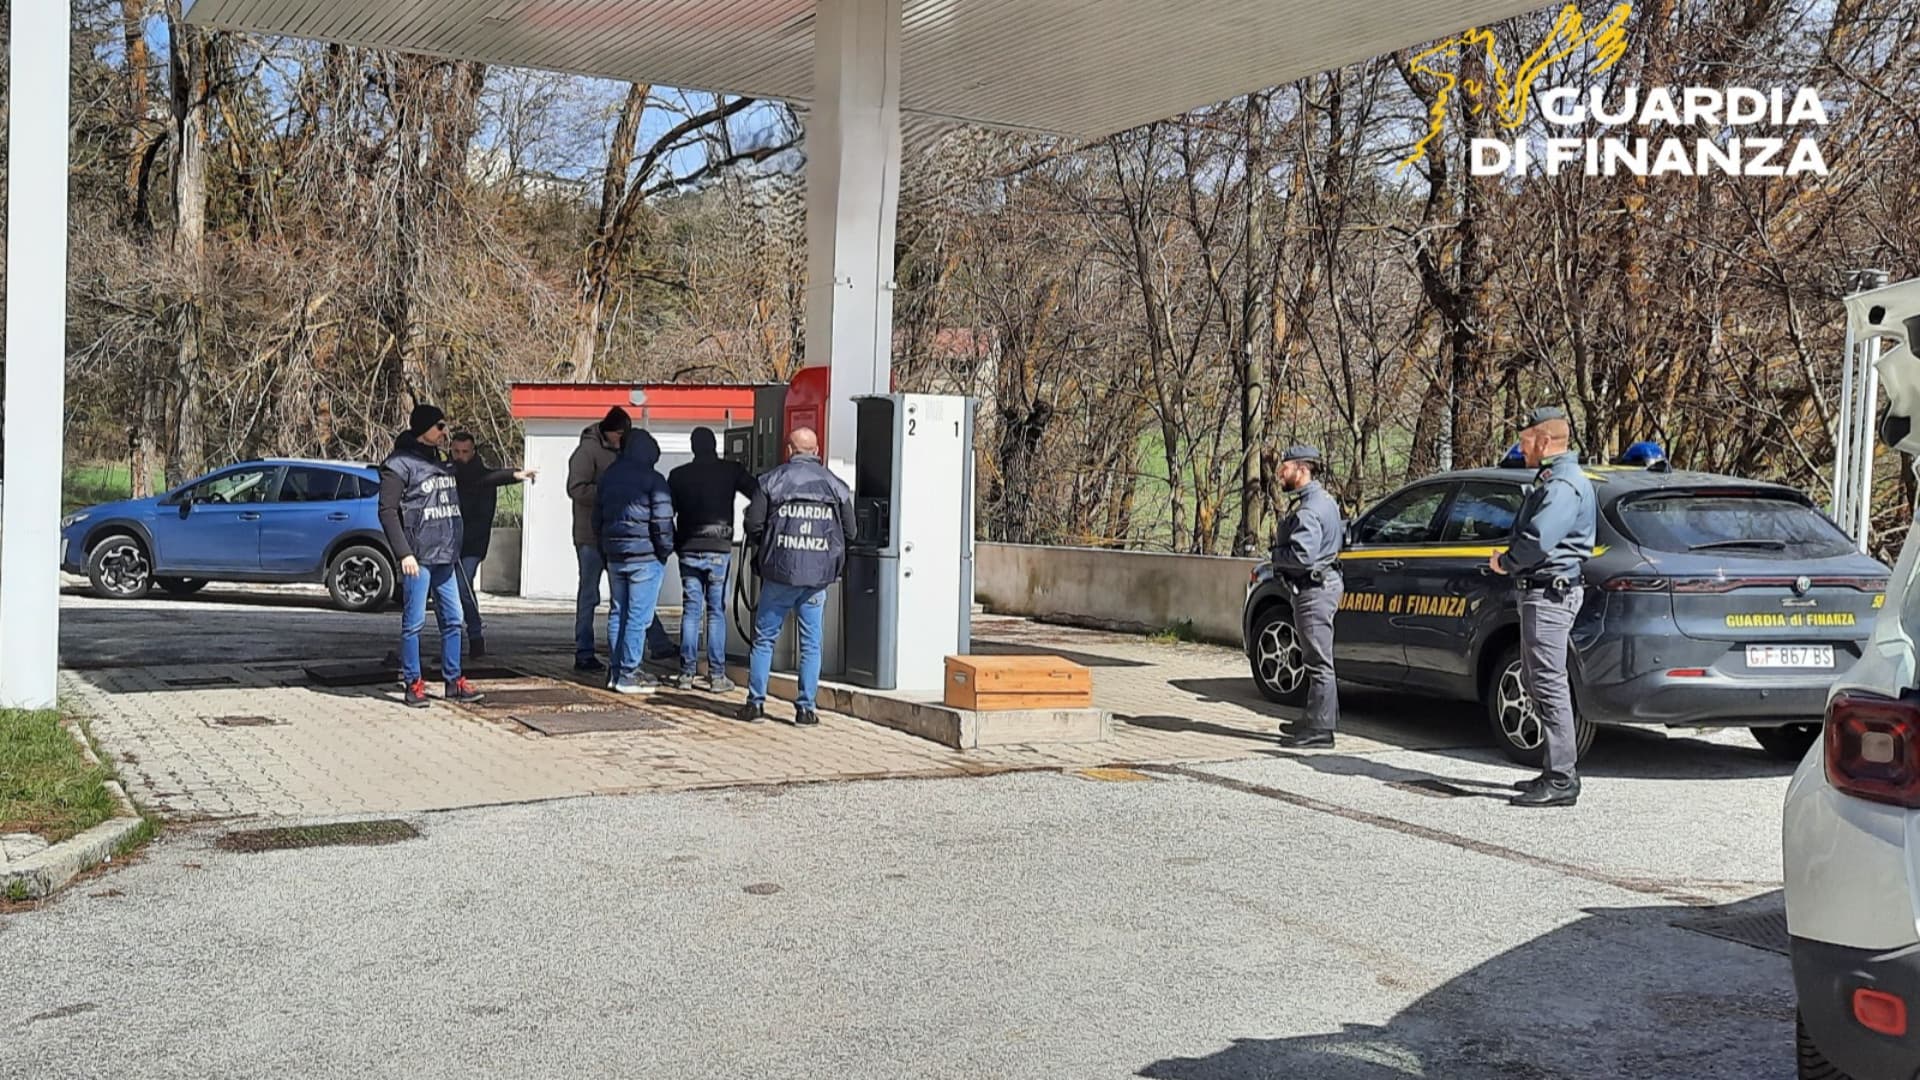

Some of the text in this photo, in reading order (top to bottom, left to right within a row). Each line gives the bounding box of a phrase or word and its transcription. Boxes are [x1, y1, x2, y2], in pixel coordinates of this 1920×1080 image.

[908, 418, 916, 436] 2
[953, 421, 959, 438] 1
[778, 504, 833, 520] GUARDIA
[800, 521, 812, 535] di
[777, 534, 829, 551] FINANZA
[1339, 592, 1467, 617] UARDIA di FINANZA
[1726, 613, 1855, 627] GUARDIA di FINANZA
[1780, 647, 1808, 665] 867
[1813, 647, 1831, 665] BS
